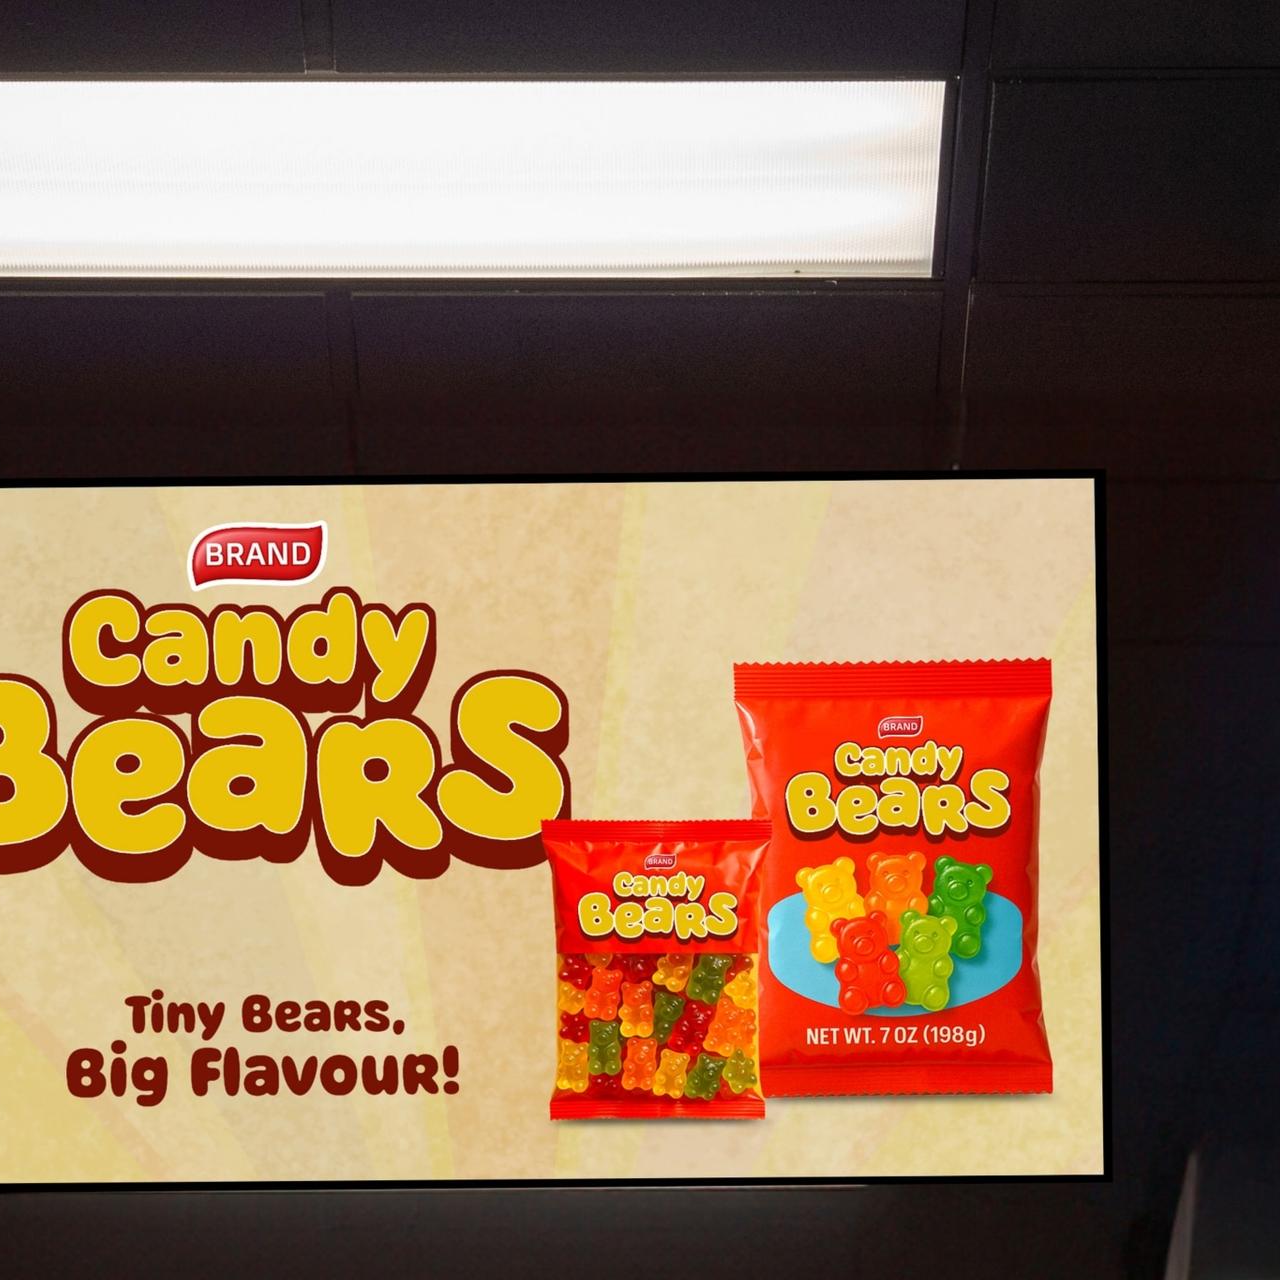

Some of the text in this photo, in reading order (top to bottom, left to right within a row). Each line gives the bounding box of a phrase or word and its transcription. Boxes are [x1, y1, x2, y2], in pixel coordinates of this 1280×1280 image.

[204, 541, 312, 568] BRAND
[68, 593, 430, 703] Candy
[883, 722, 918, 731] BRAND
[835, 740, 963, 781] Candy
[613, 871, 705, 901] Candy
[124, 989, 225, 1040] Tiny
[806, 1024, 986, 1047] NET WT. 7 OZ (198g)
[66, 1040, 168, 1107] Big
